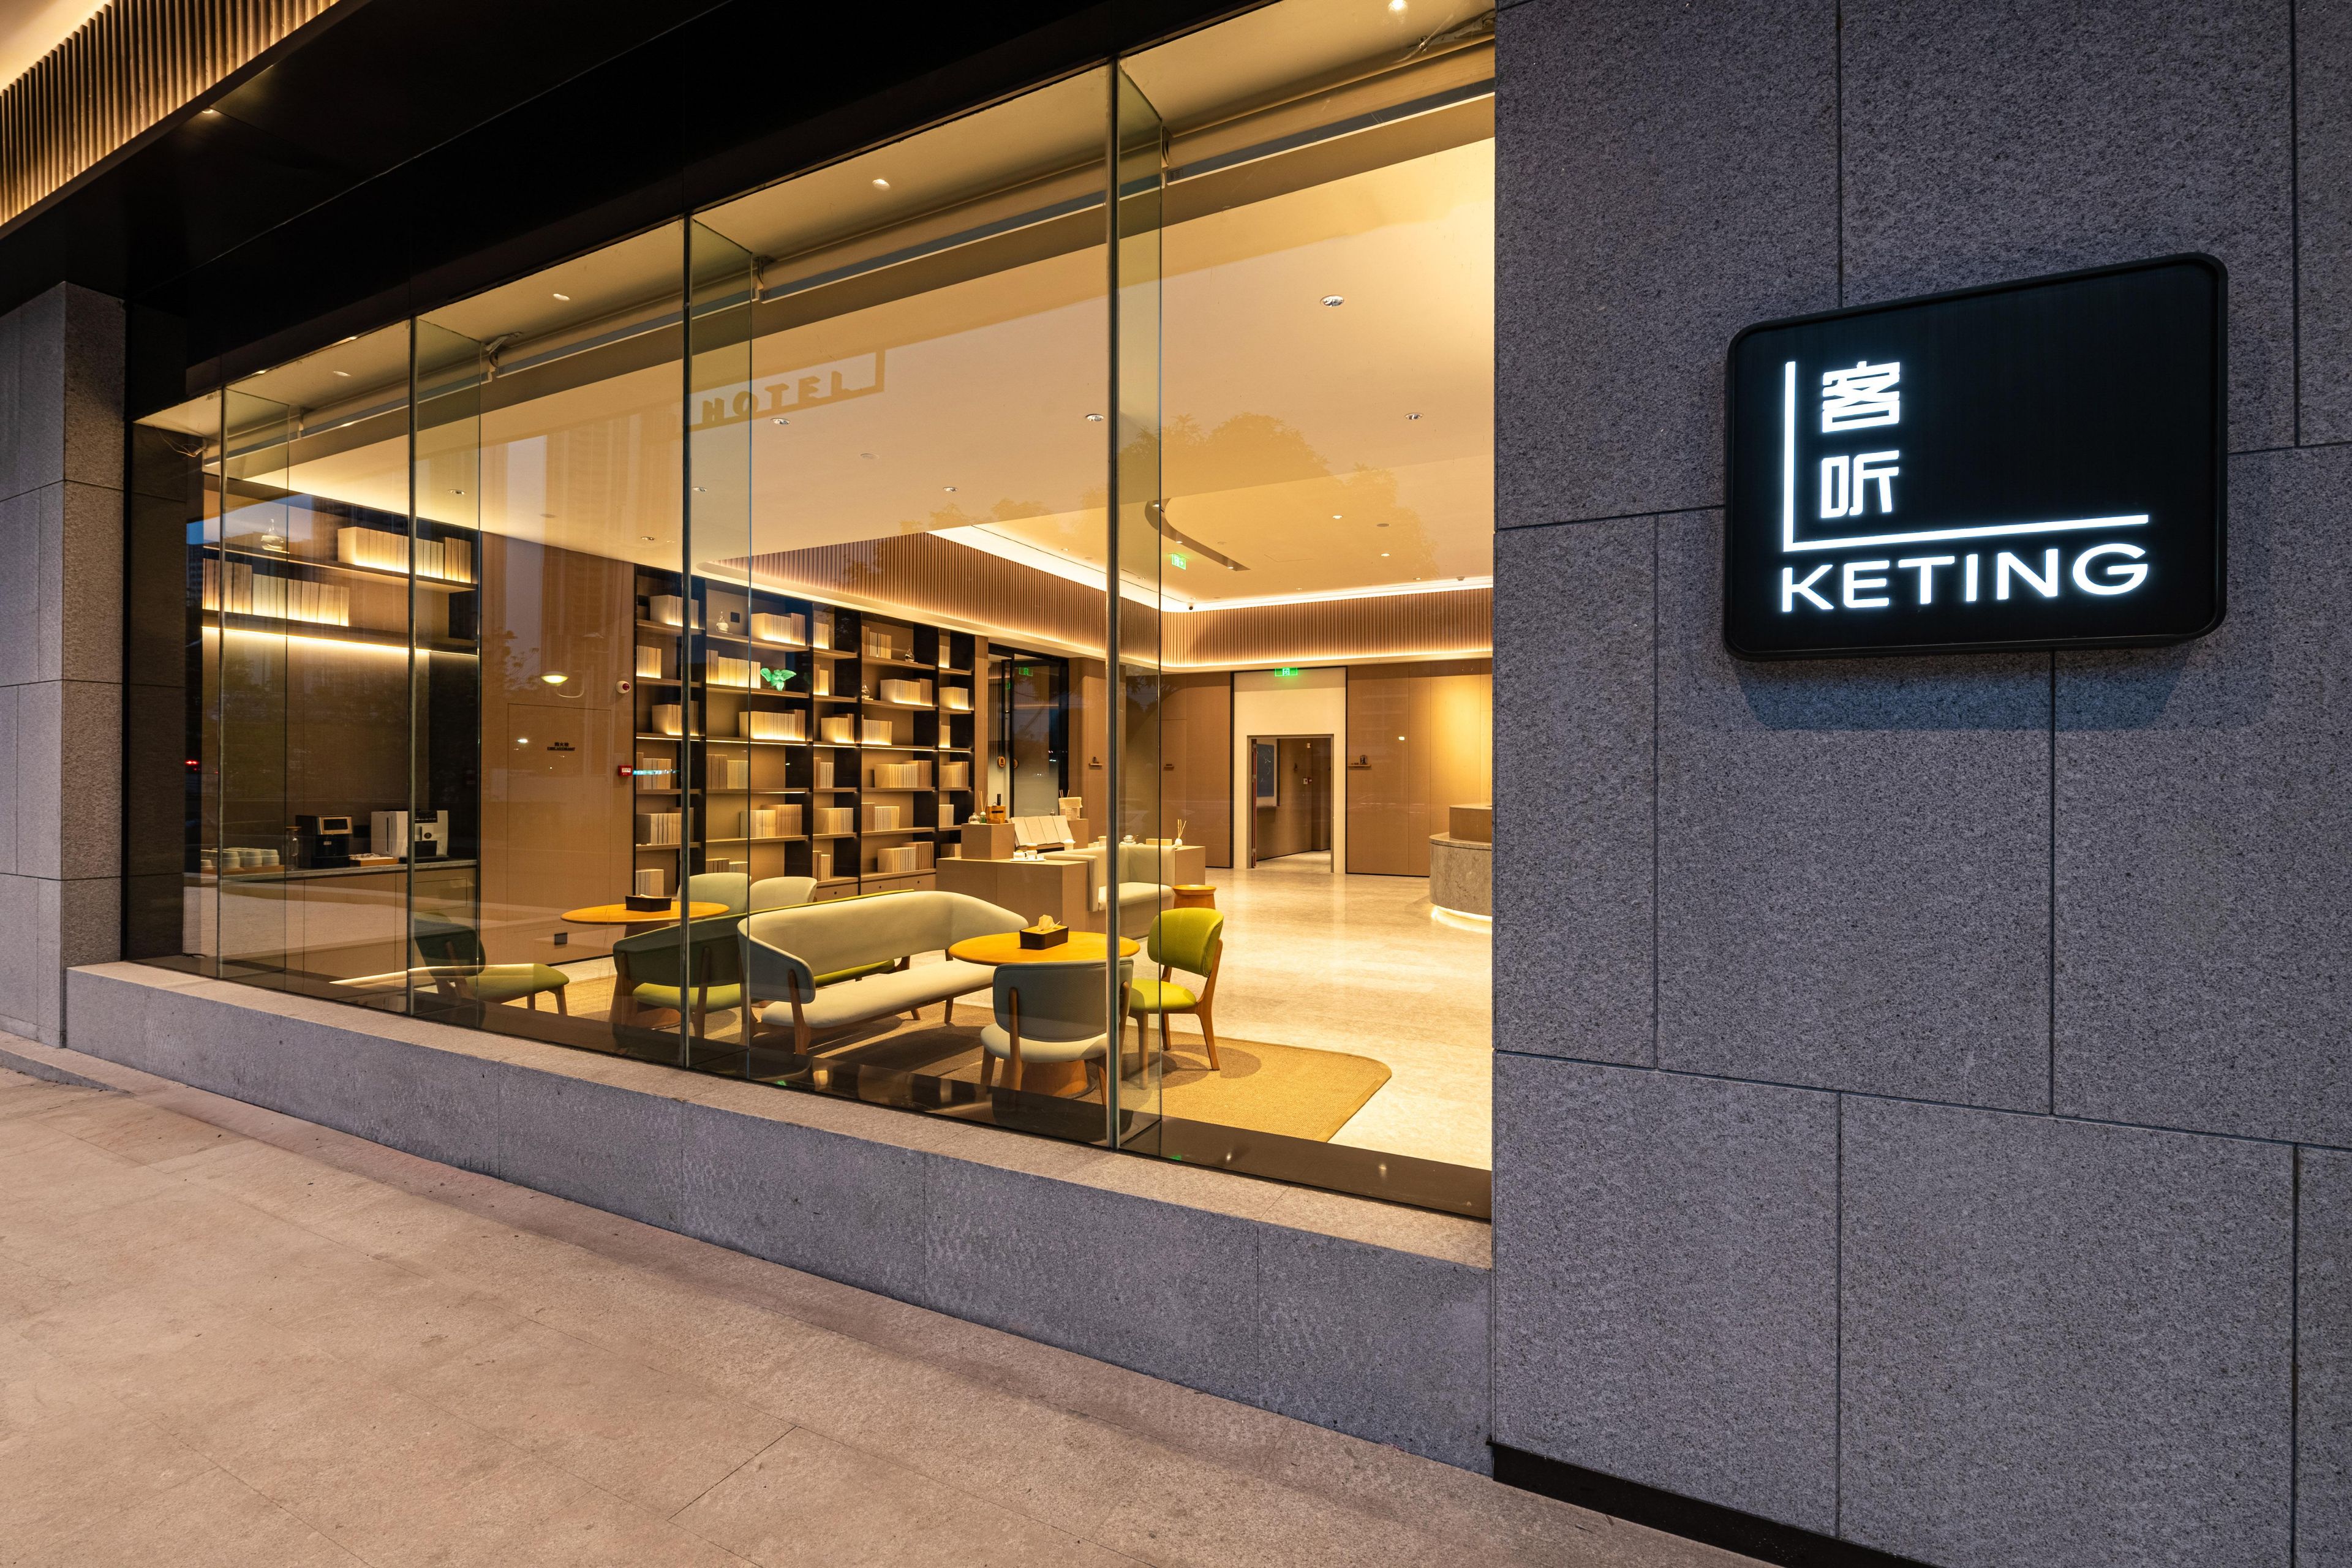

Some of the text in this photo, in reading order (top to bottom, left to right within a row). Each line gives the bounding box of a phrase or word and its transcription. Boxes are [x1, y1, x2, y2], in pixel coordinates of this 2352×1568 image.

[702, 370, 852, 423] HOTEL
[1820, 360, 1901, 519] 客听
[1781, 543, 2149, 613] KETING
